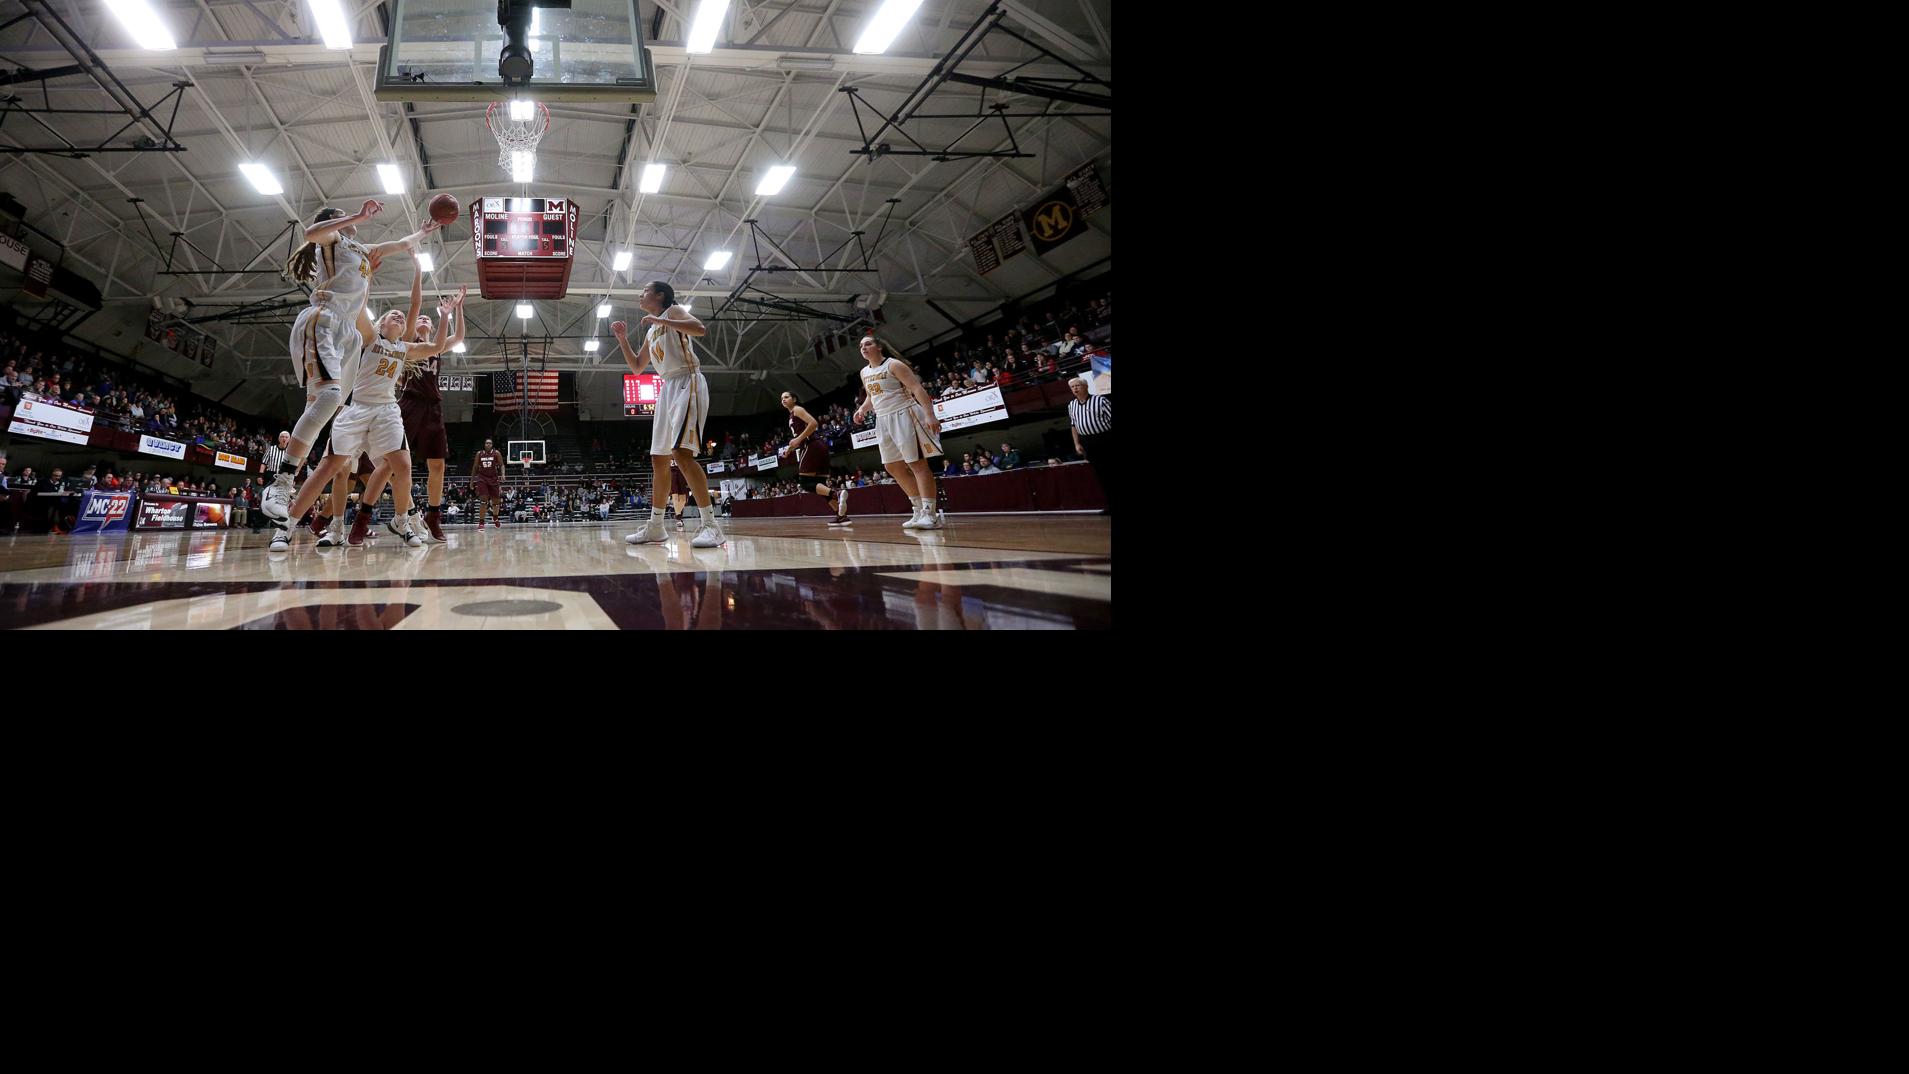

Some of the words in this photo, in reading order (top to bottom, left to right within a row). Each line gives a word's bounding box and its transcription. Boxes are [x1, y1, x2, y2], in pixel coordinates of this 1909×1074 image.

[547, 200, 565, 212] M
[472, 203, 482, 257] MAROONS
[569, 206, 577, 256] MOLINE
[1037, 204, 1068, 238] M
[375, 357, 398, 379] 24
[145, 506, 171, 515] Wharton
[151, 514, 184, 522] Fieldhouse
